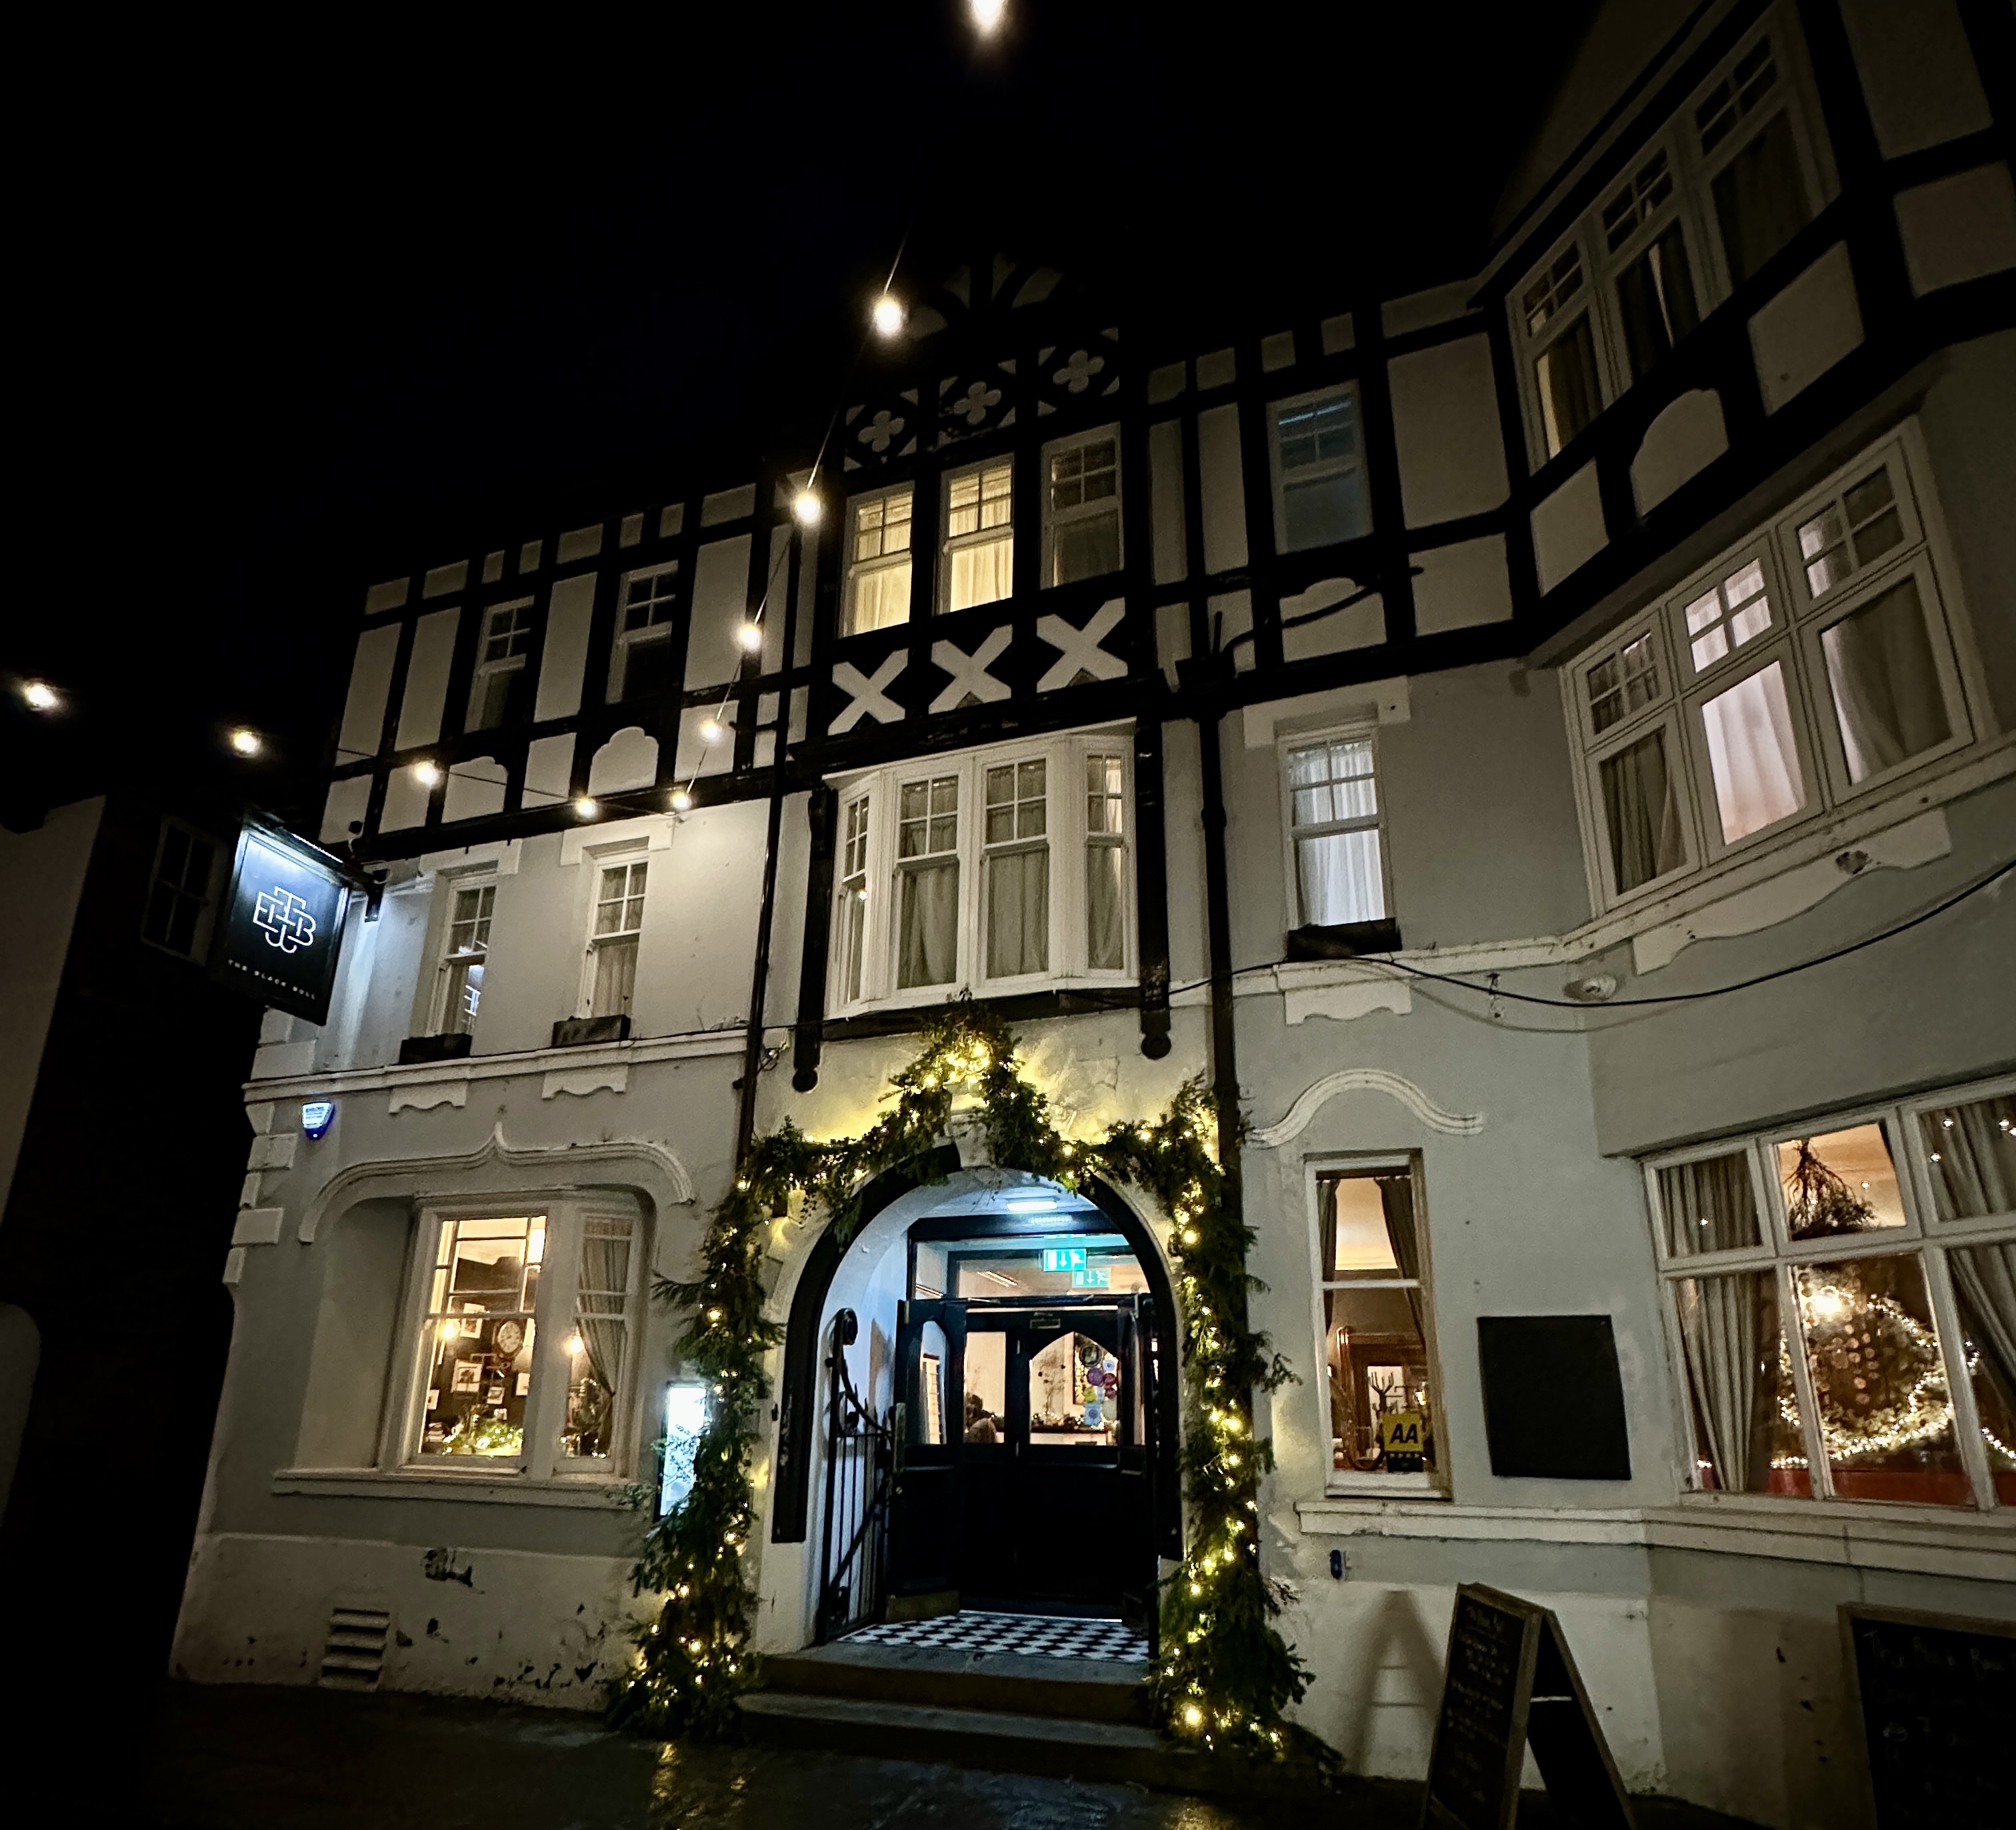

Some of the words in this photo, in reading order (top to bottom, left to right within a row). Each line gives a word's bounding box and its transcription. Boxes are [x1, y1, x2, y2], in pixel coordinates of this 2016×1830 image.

[228, 959, 248, 971] THE
[254, 970, 287, 987] BLACK
[292, 986, 316, 1000] BULL
[1390, 1423, 1418, 1443] AA
